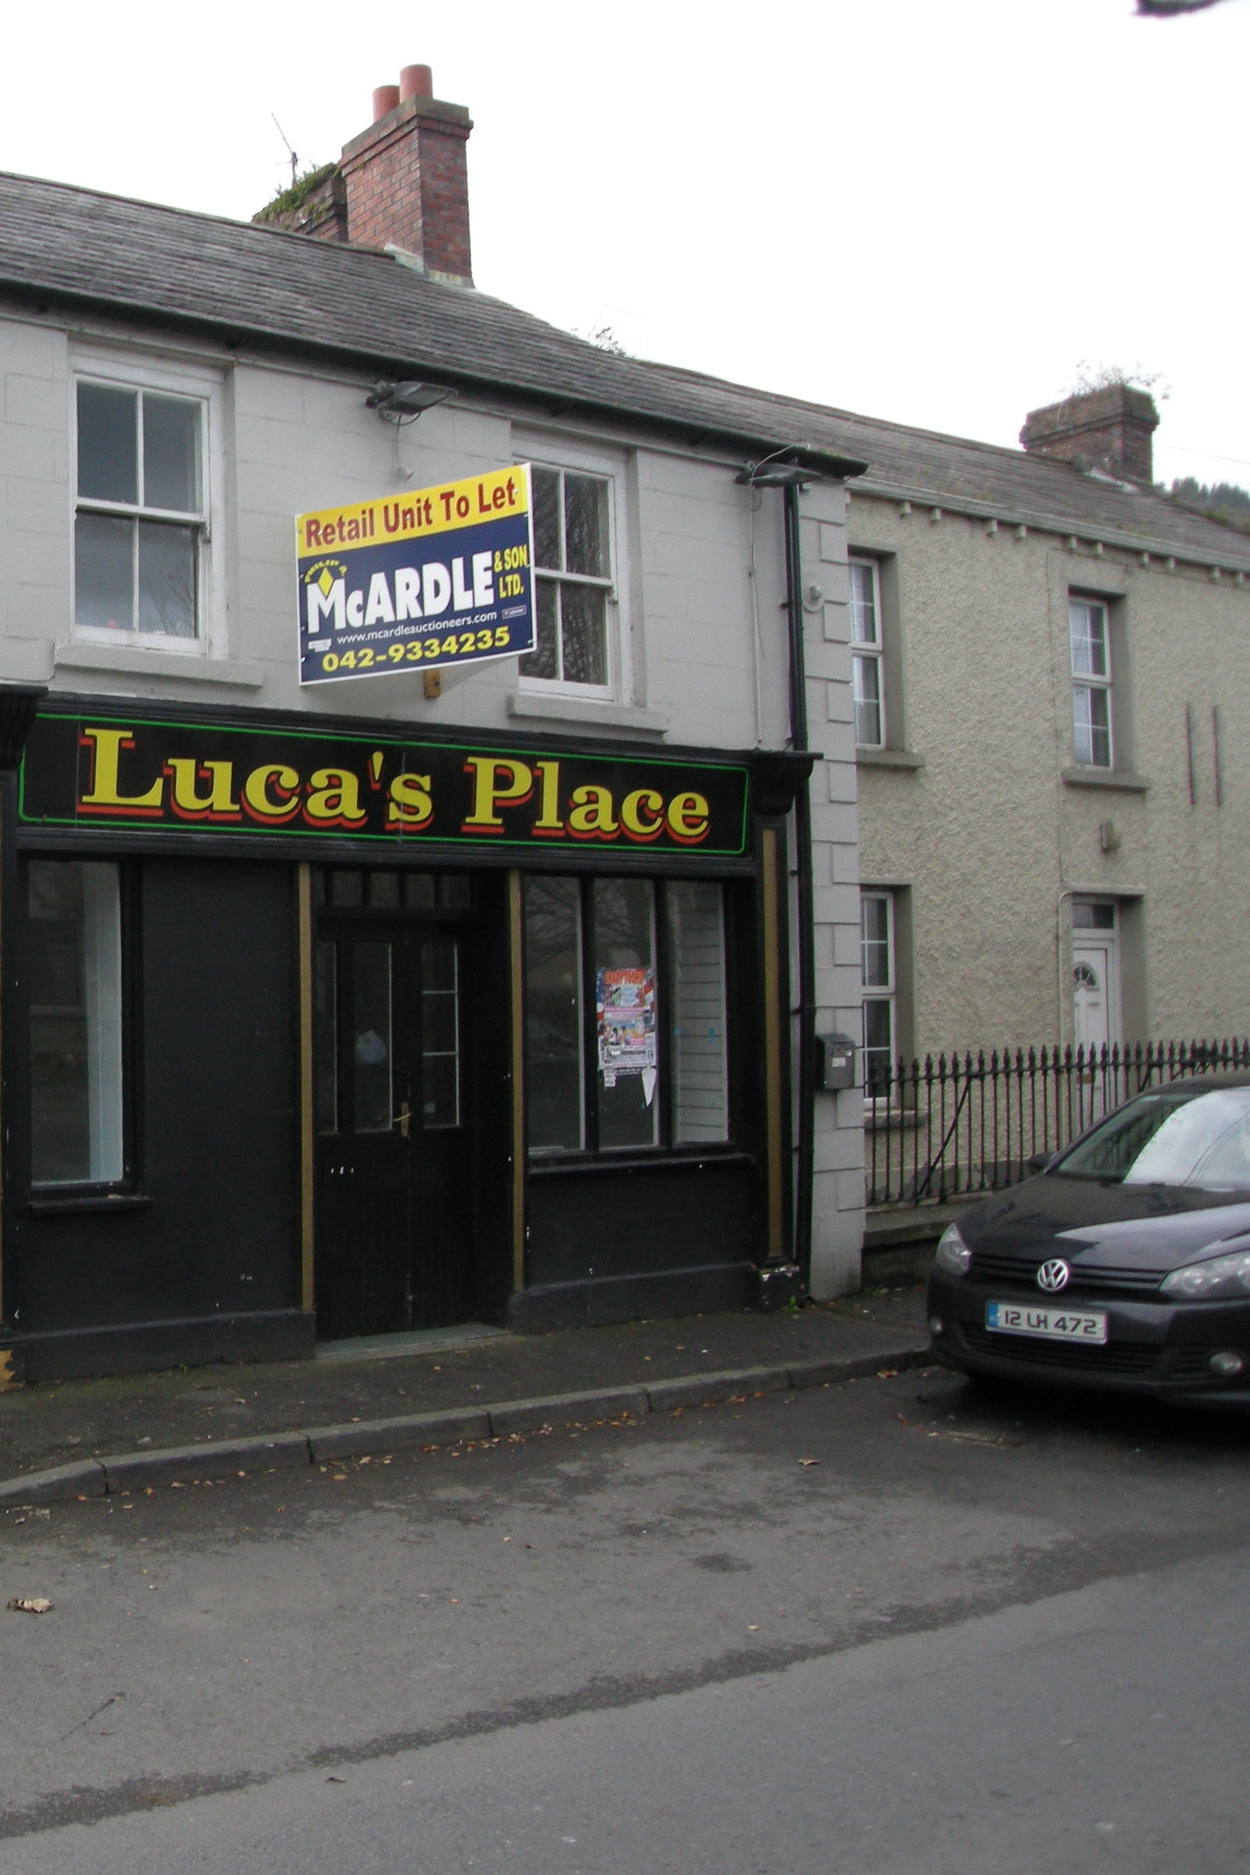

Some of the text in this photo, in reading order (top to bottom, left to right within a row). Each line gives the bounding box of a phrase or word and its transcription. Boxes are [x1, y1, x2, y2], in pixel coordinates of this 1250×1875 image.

[305, 476, 516, 549] Retail Unit To Let
[493, 544, 528, 573] & SON
[306, 550, 495, 634] McARDLE
[498, 572, 525, 599] LTD.
[336, 610, 498, 645] www.mcardleauctioneers.com
[321, 625, 511, 673] 042-9334235
[78, 727, 710, 843] Luca's Place
[1005, 1310, 1098, 1335] 12 LH 472
